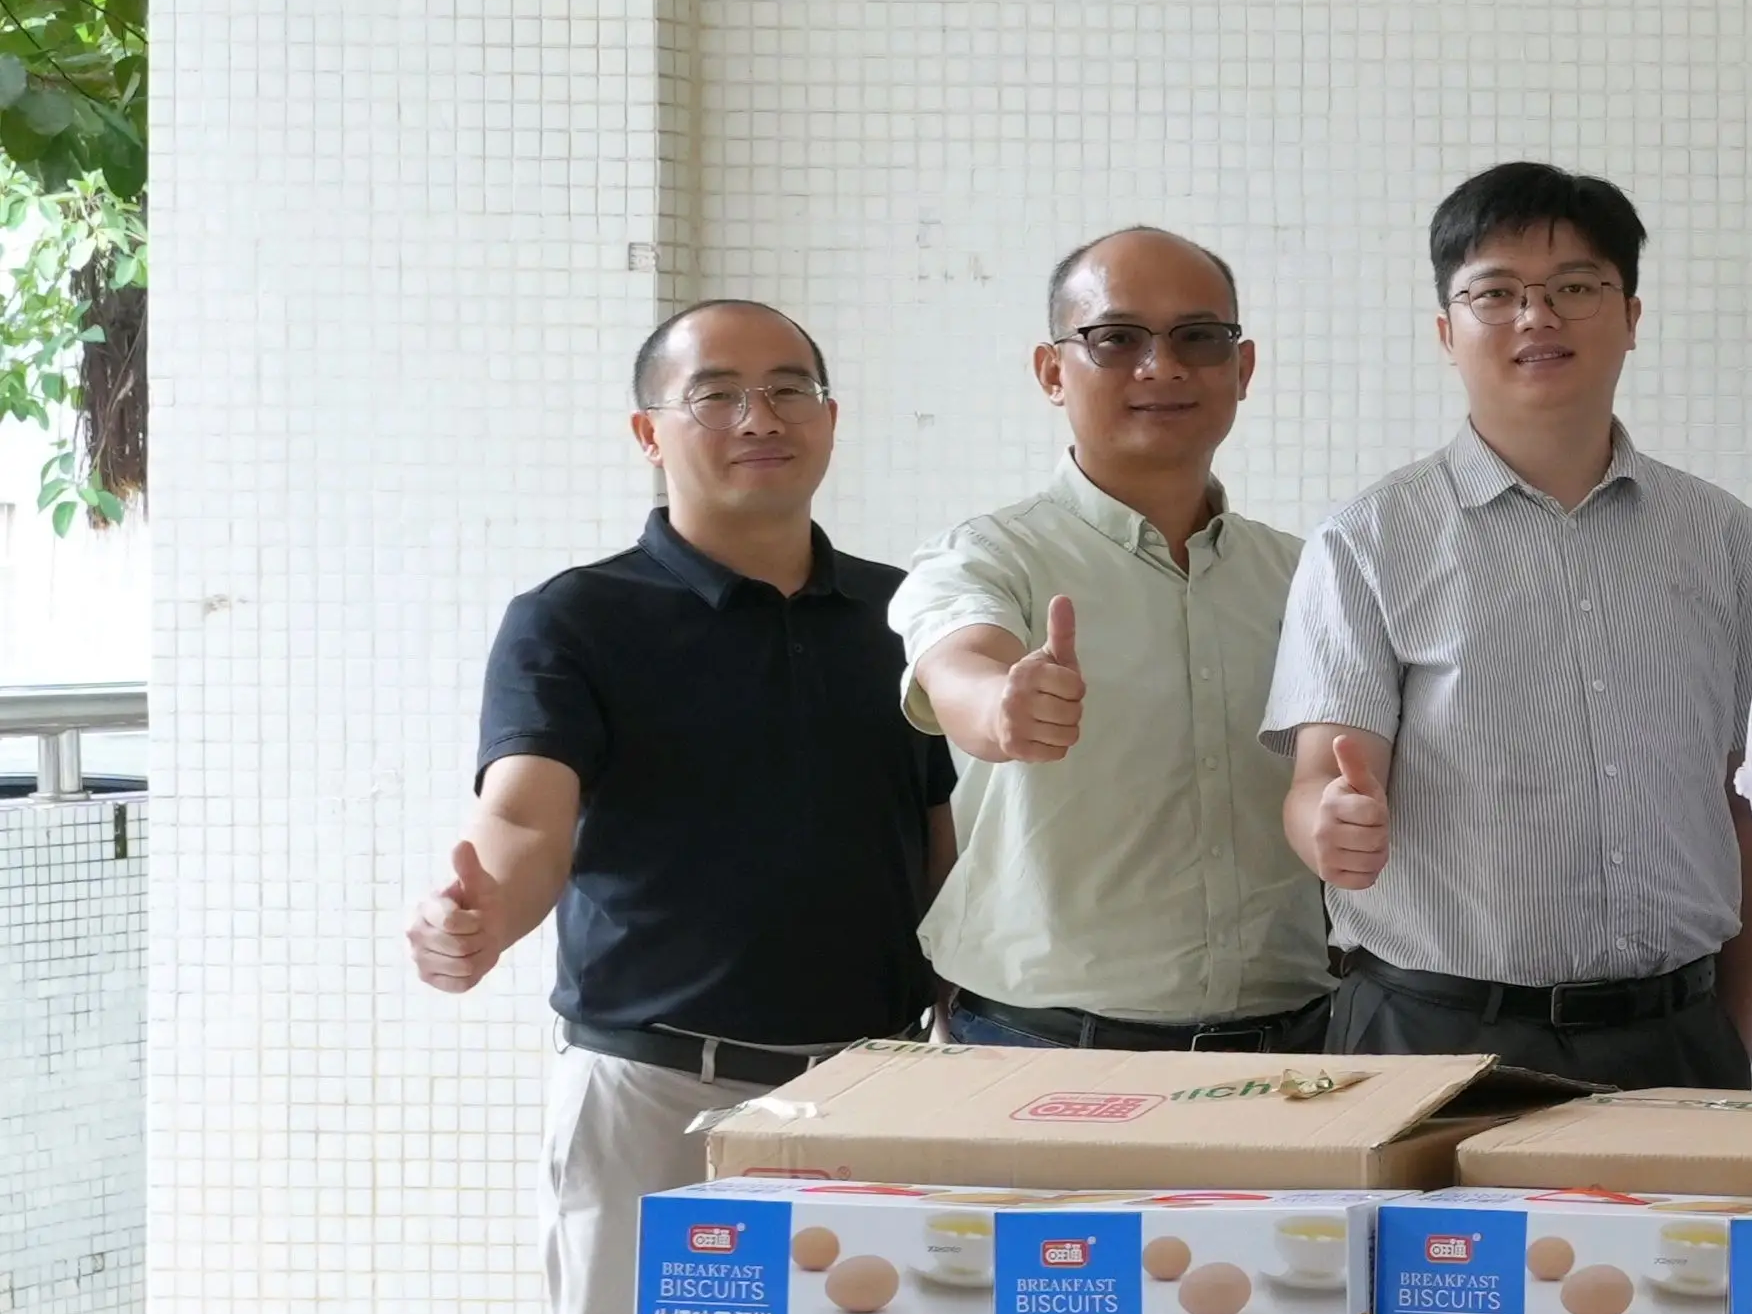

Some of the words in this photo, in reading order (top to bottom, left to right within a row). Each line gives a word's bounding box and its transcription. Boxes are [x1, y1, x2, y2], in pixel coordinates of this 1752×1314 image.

[662, 1262, 763, 1280] BREAKFAST
[661, 1279, 764, 1300] BISCUITS
[1016, 1277, 1116, 1295] BREAKFAST
[1400, 1272, 1499, 1290] BREAKFAST
[1016, 1294, 1118, 1314] BISCUITS
[1399, 1289, 1500, 1310] BISCUITS
